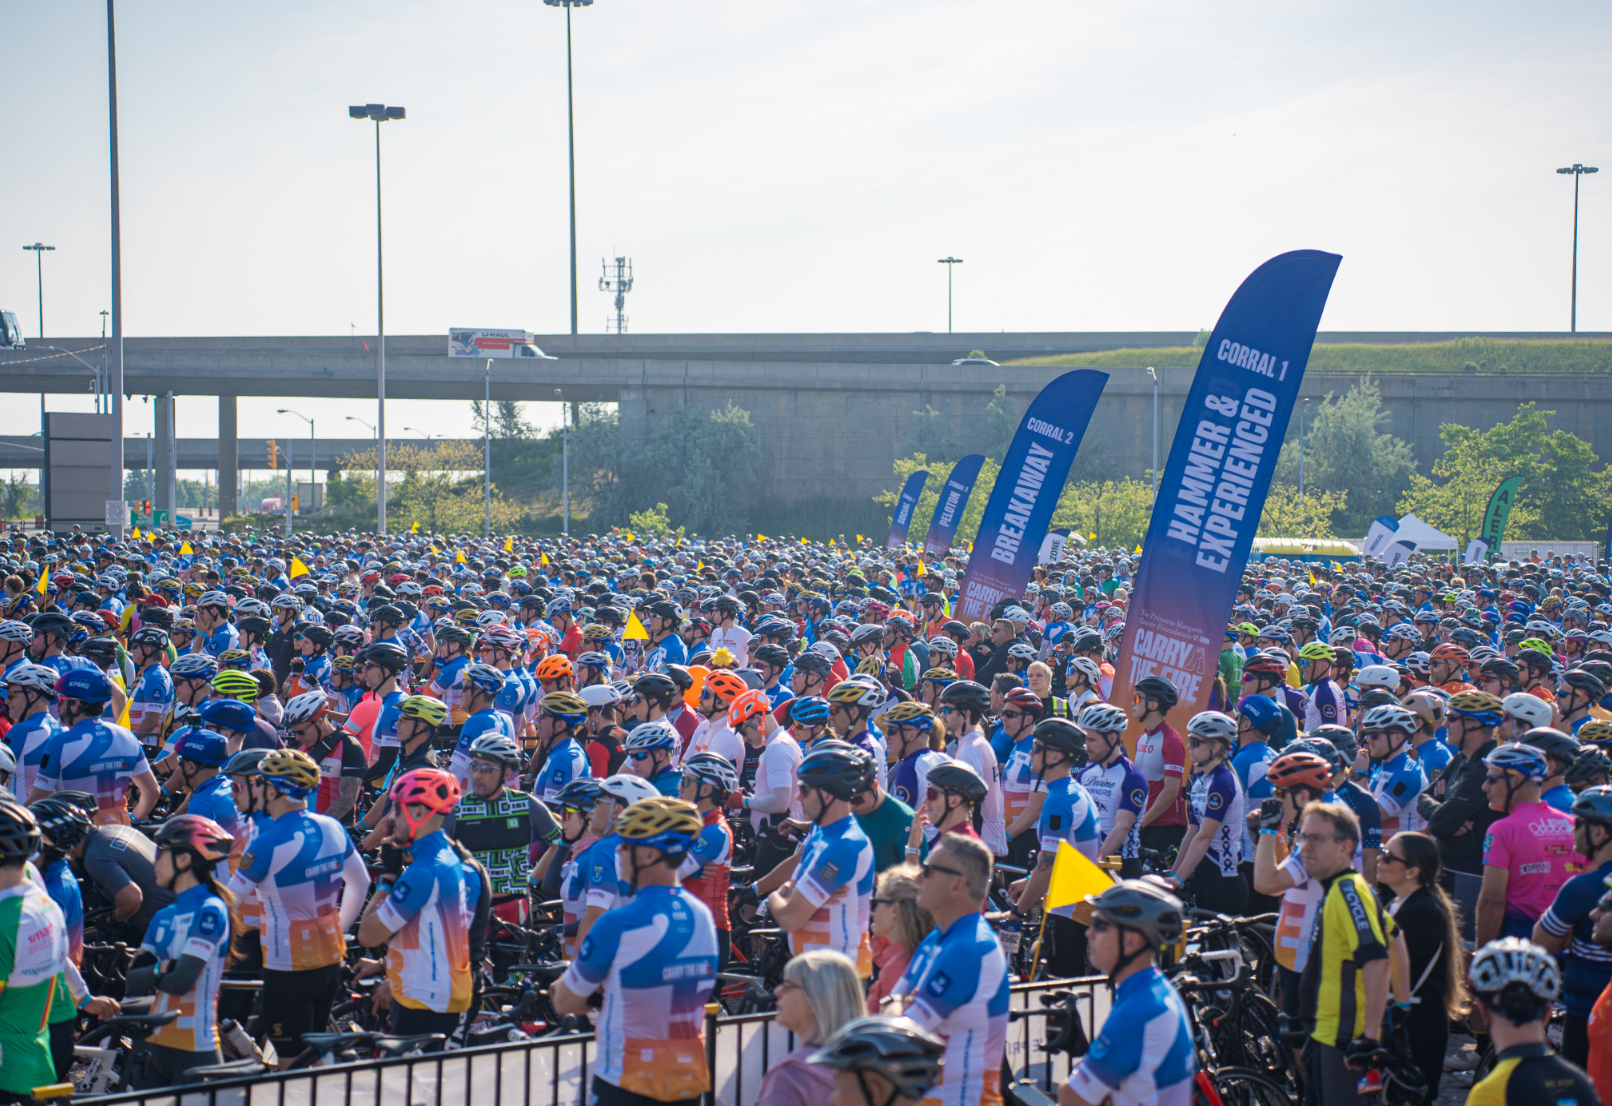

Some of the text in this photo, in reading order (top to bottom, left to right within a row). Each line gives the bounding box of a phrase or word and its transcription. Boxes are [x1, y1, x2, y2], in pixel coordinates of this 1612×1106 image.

[1217, 338, 1290, 382] CORRAL 1
[1026, 416, 1074, 445] CORRAL 2
[1166, 393, 1241, 546] HAMMER &
[1195, 386, 1277, 574] EXPERIENCED
[897, 502, 910, 525] SOCIAL
[938, 490, 961, 528] PELOTON
[990, 441, 1054, 566] BREAKAWAY
[1050, 539, 1060, 562] ZONE
[1369, 534, 1384, 552] MEDICAL
[966, 581, 1004, 604] CARRY
[307, 612, 321, 623] citi
[963, 597, 983, 617] THE
[1139, 616, 1210, 645] Cancer Foundation UHN
[1141, 608, 1203, 634] The Princess Margaret
[1133, 628, 1194, 668] CARRY
[68, 681, 90, 690] KPMG
[185, 742, 205, 751] KPMG
[28, 923, 54, 943] smart
[1000, 933, 1018, 943] 3562
